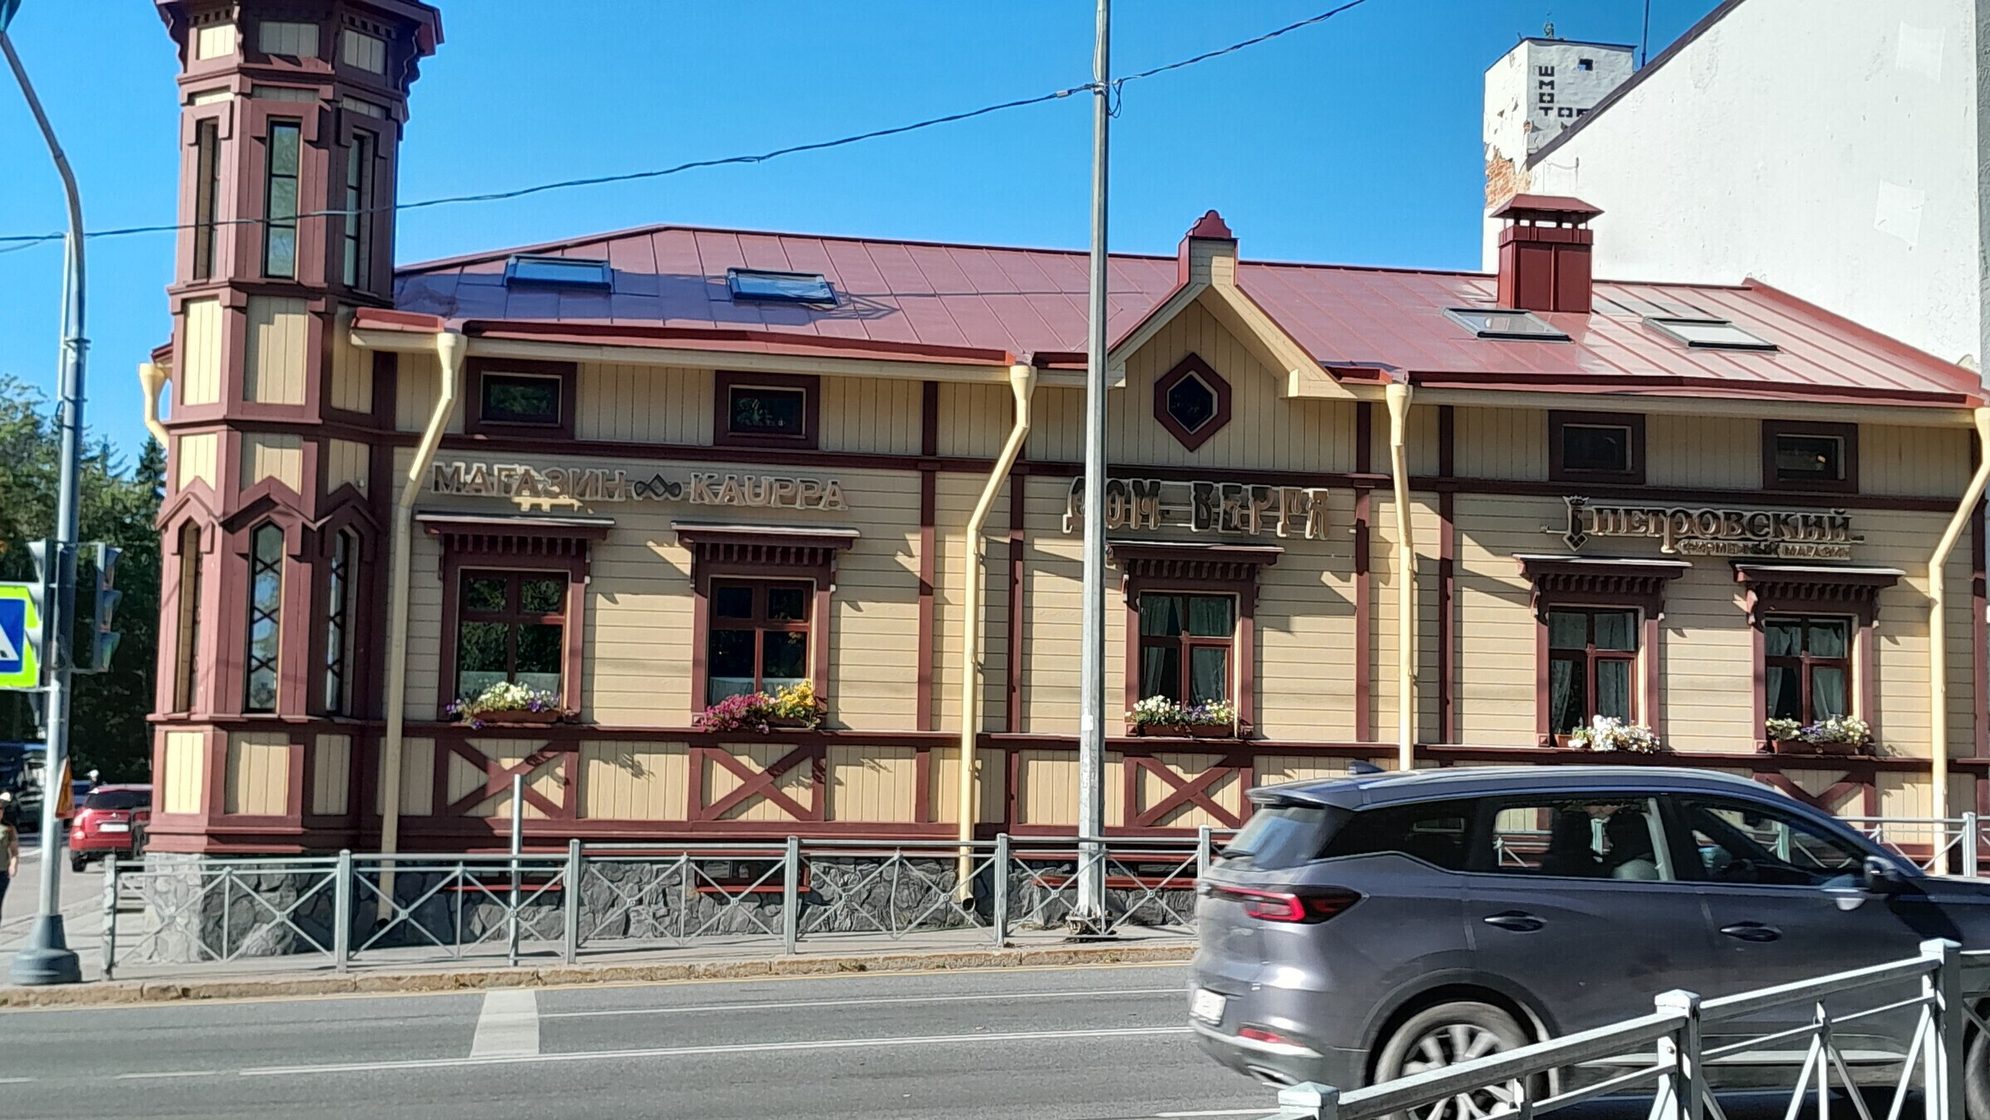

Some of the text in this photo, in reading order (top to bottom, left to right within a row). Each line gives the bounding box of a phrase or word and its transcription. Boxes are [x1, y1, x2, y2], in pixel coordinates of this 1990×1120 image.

[431, 461, 626, 501] МАГАЗИН
[689, 472, 849, 510] KAUPPA
[1591, 506, 1851, 554] ПЕТРОВСКИЙ
[1782, 544, 1851, 560] МАГАЗИН
